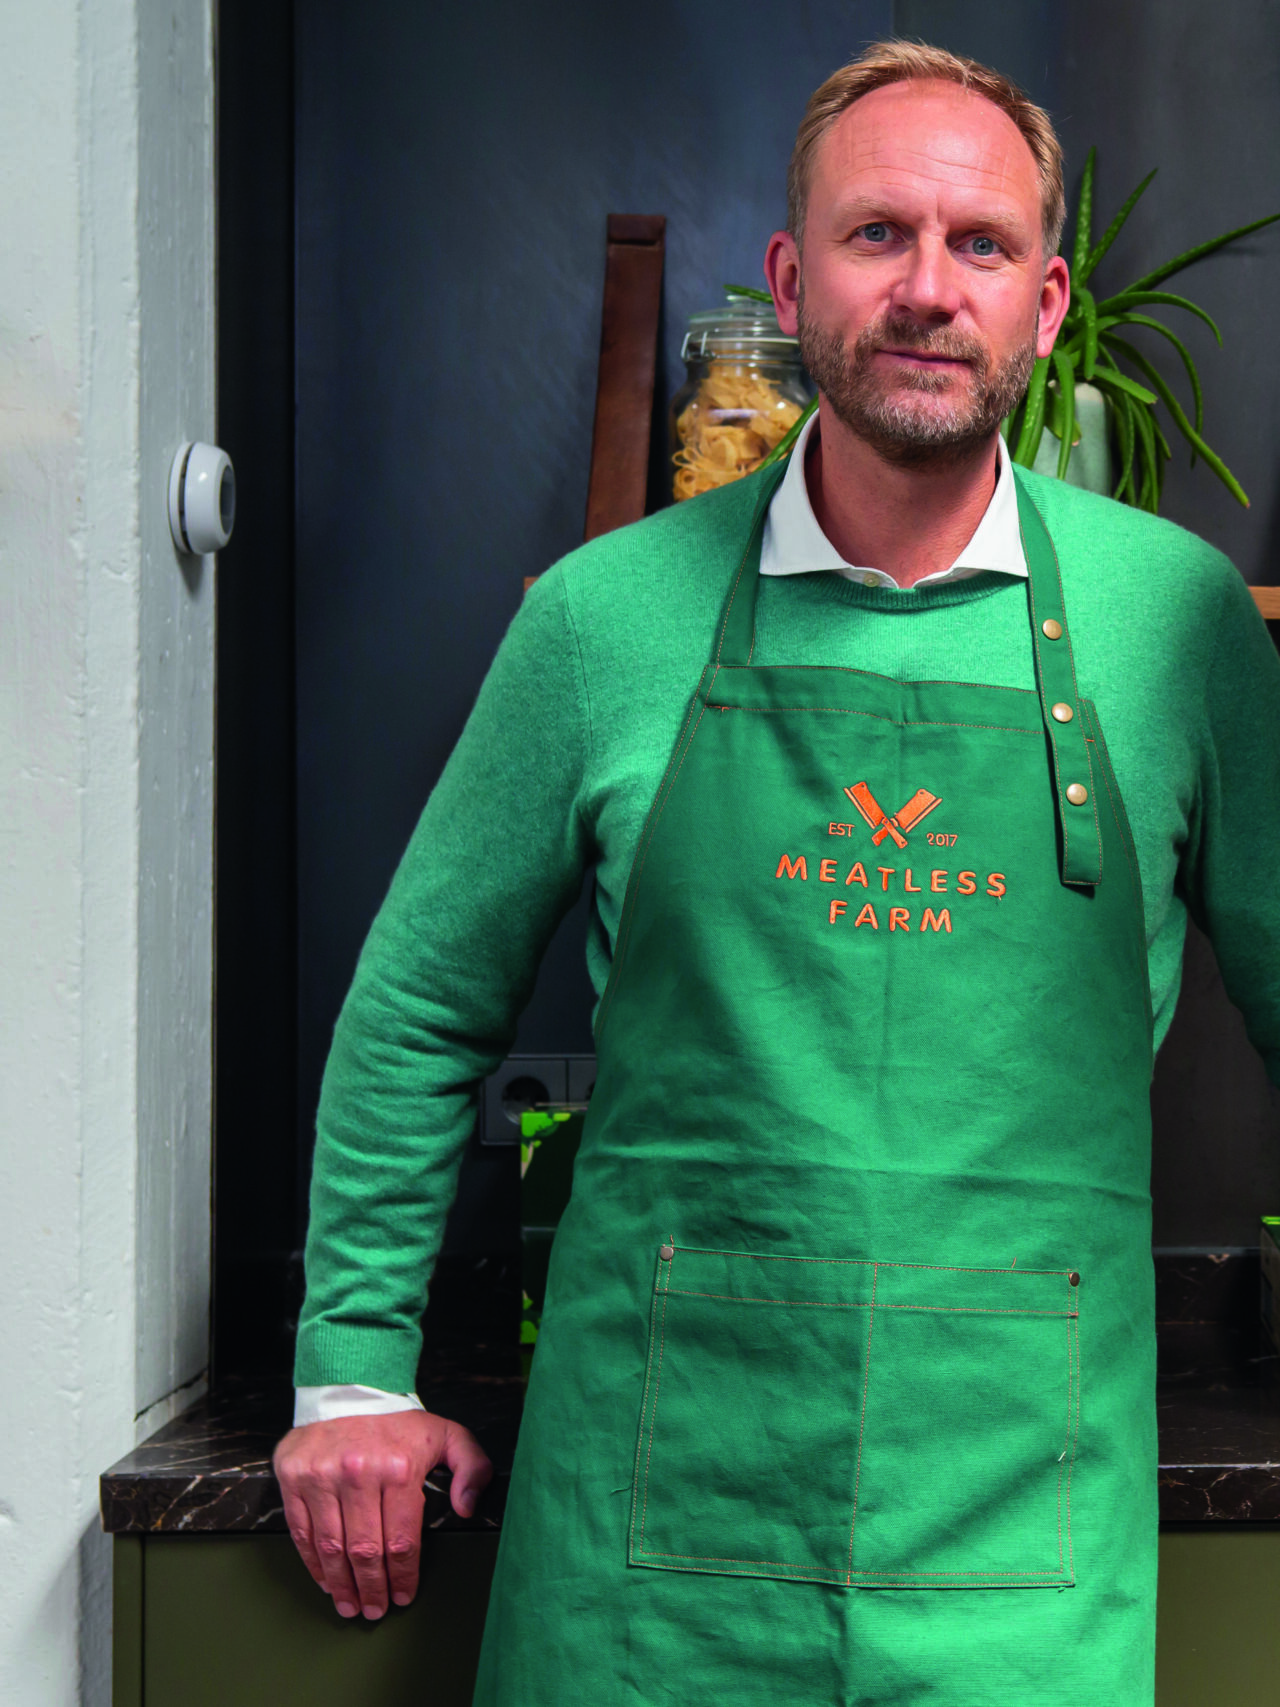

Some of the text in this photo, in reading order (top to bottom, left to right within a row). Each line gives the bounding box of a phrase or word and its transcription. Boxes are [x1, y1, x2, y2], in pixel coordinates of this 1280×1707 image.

[828, 822, 958, 848] EST 2017
[775, 853, 1007, 898] MEATLESS
[829, 899, 952, 934] FARM
